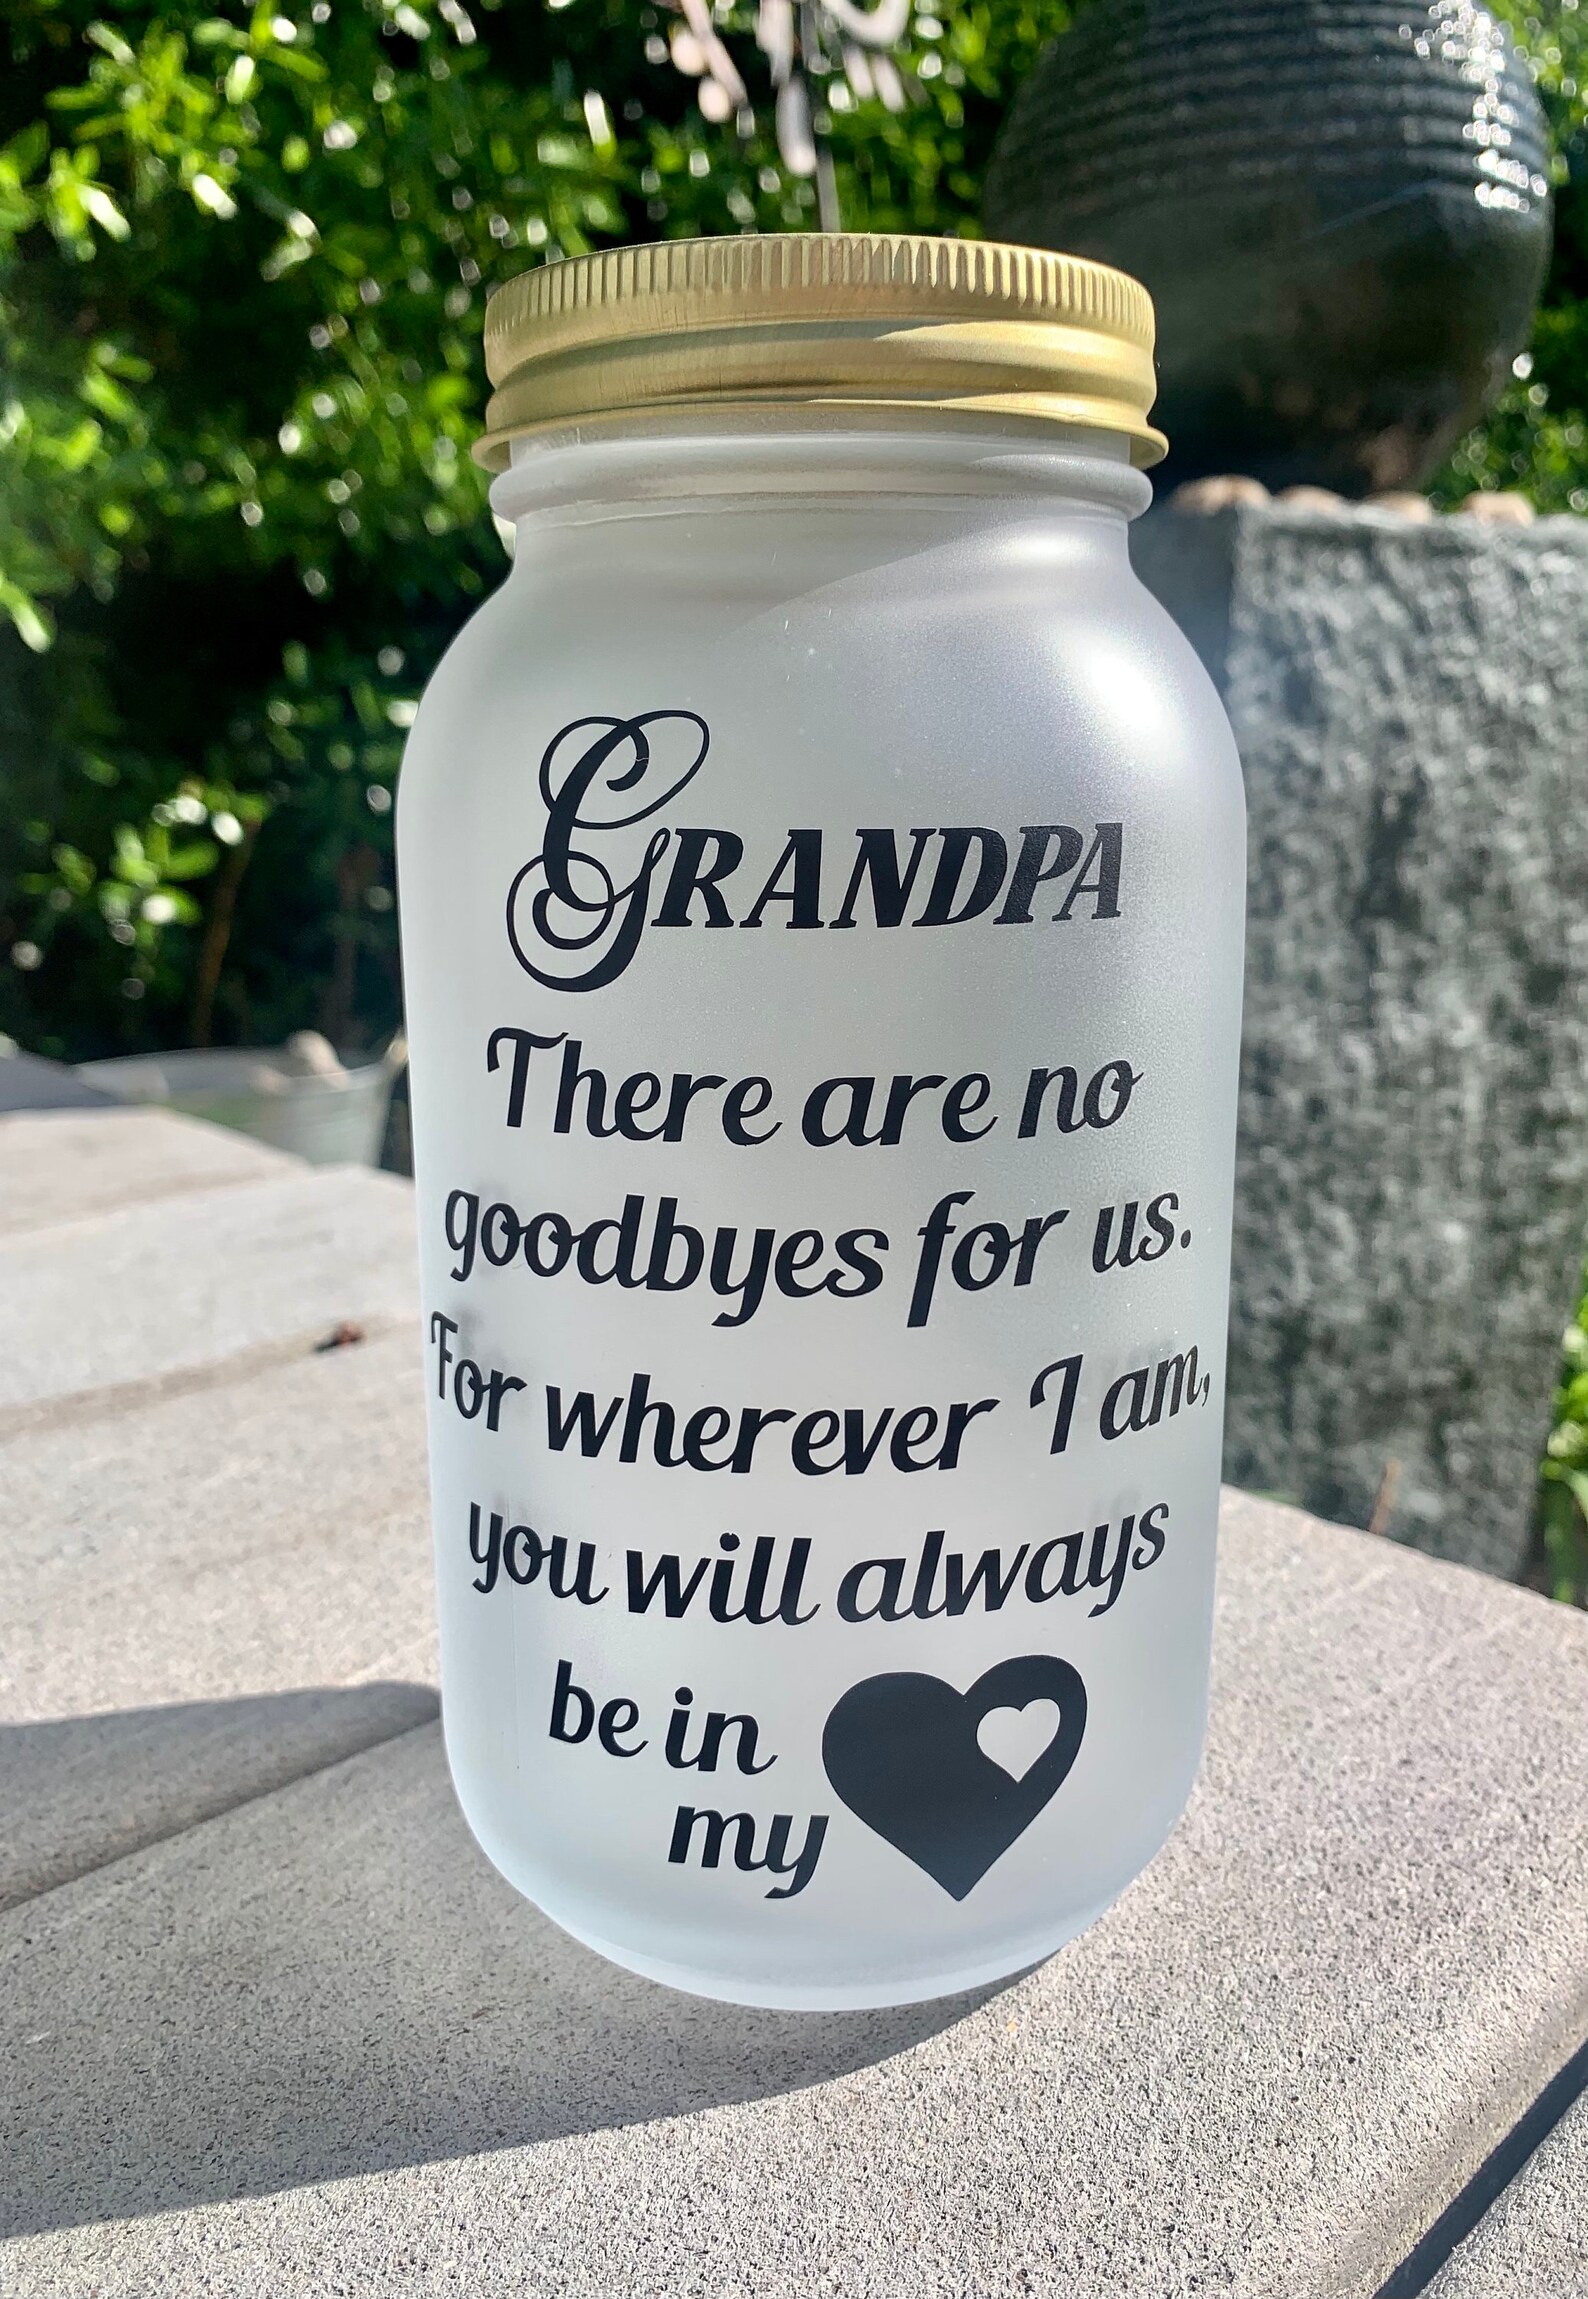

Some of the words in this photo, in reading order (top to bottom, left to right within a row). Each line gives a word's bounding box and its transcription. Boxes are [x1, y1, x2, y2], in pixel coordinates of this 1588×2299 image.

[506, 709, 1125, 993] GRANDPA
[487, 1026, 784, 1147] There
[801, 1072, 999, 1148] are
[1016, 1058, 1146, 1140] no
[444, 1188, 890, 1329] goodbyes
[906, 1190, 1070, 1328] for
[1091, 1191, 1194, 1275] us.
[430, 1310, 528, 1432] For
[545, 1372, 1001, 1476] wherever
[1029, 1352, 1085, 1455] I
[1099, 1344, 1211, 1441] am,
[468, 1501, 611, 1606] you
[625, 1531, 822, 1626] will
[836, 1501, 1170, 1619] always
[547, 1658, 649, 1759] be
[664, 1685, 779, 1777] in
[667, 1804, 831, 1900] my
